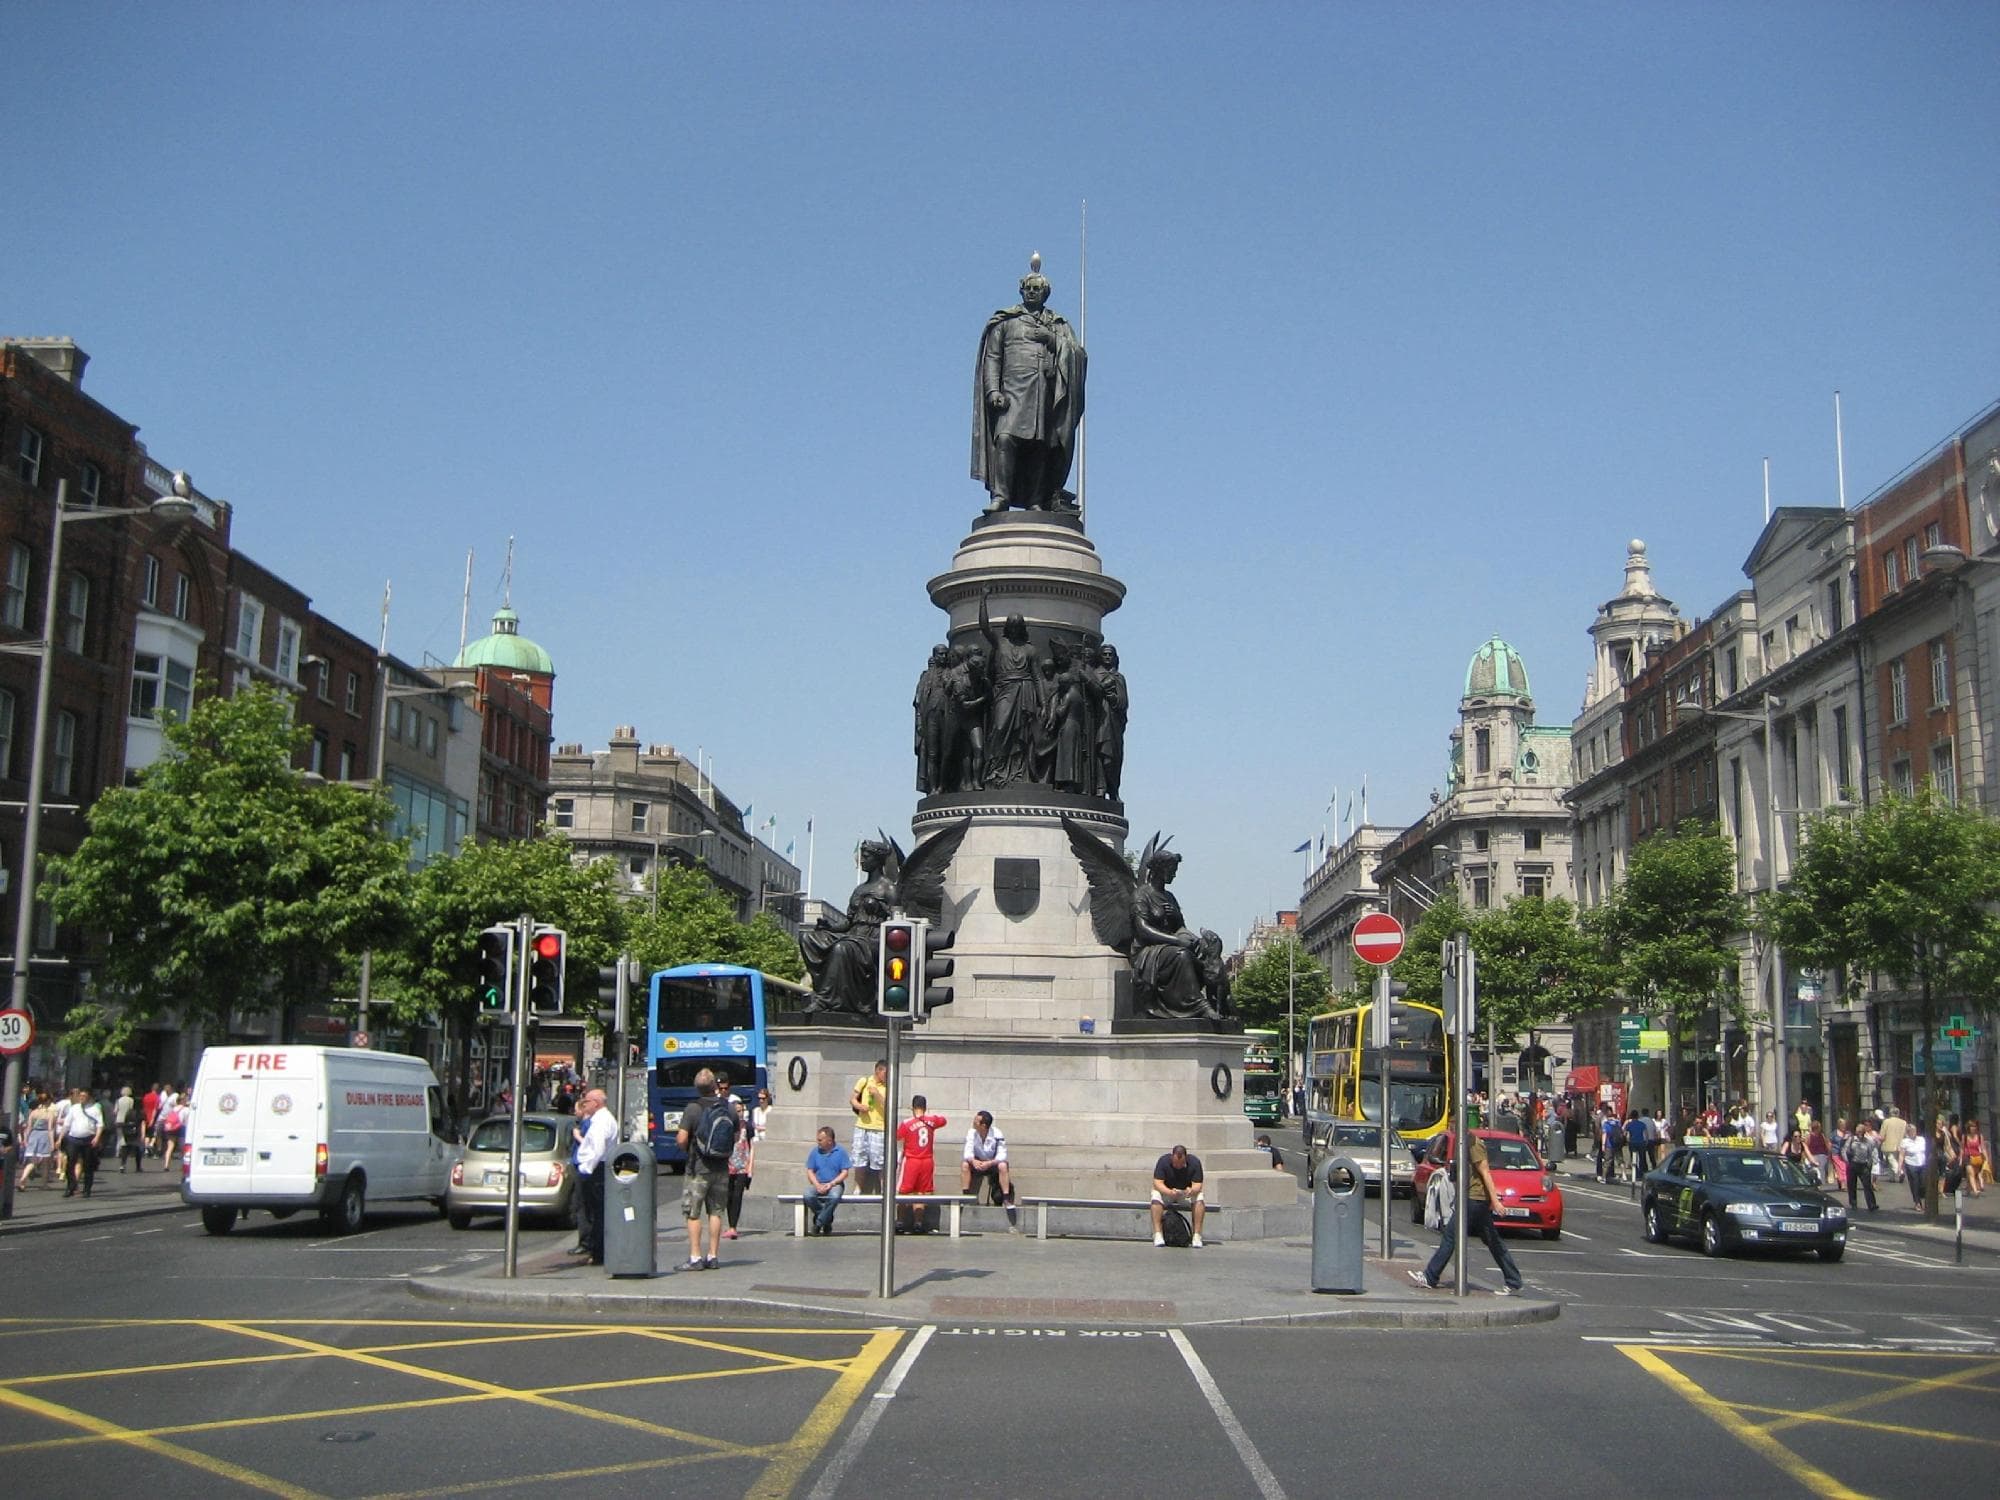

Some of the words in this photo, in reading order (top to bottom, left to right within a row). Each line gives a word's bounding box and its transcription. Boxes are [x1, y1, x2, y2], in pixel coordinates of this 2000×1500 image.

[2, 1017, 20, 1035] 30
[233, 1054, 287, 1070] FIRE
[346, 1092, 376, 1105] DUBLIN
[377, 1093, 392, 1106] FIRE
[395, 1094, 424, 1106] BRIGADE
[918, 1127, 928, 1147] 8
[940, 1328, 1066, 1337] RIGHT
[1079, 1328, 1168, 1338] LOOK
